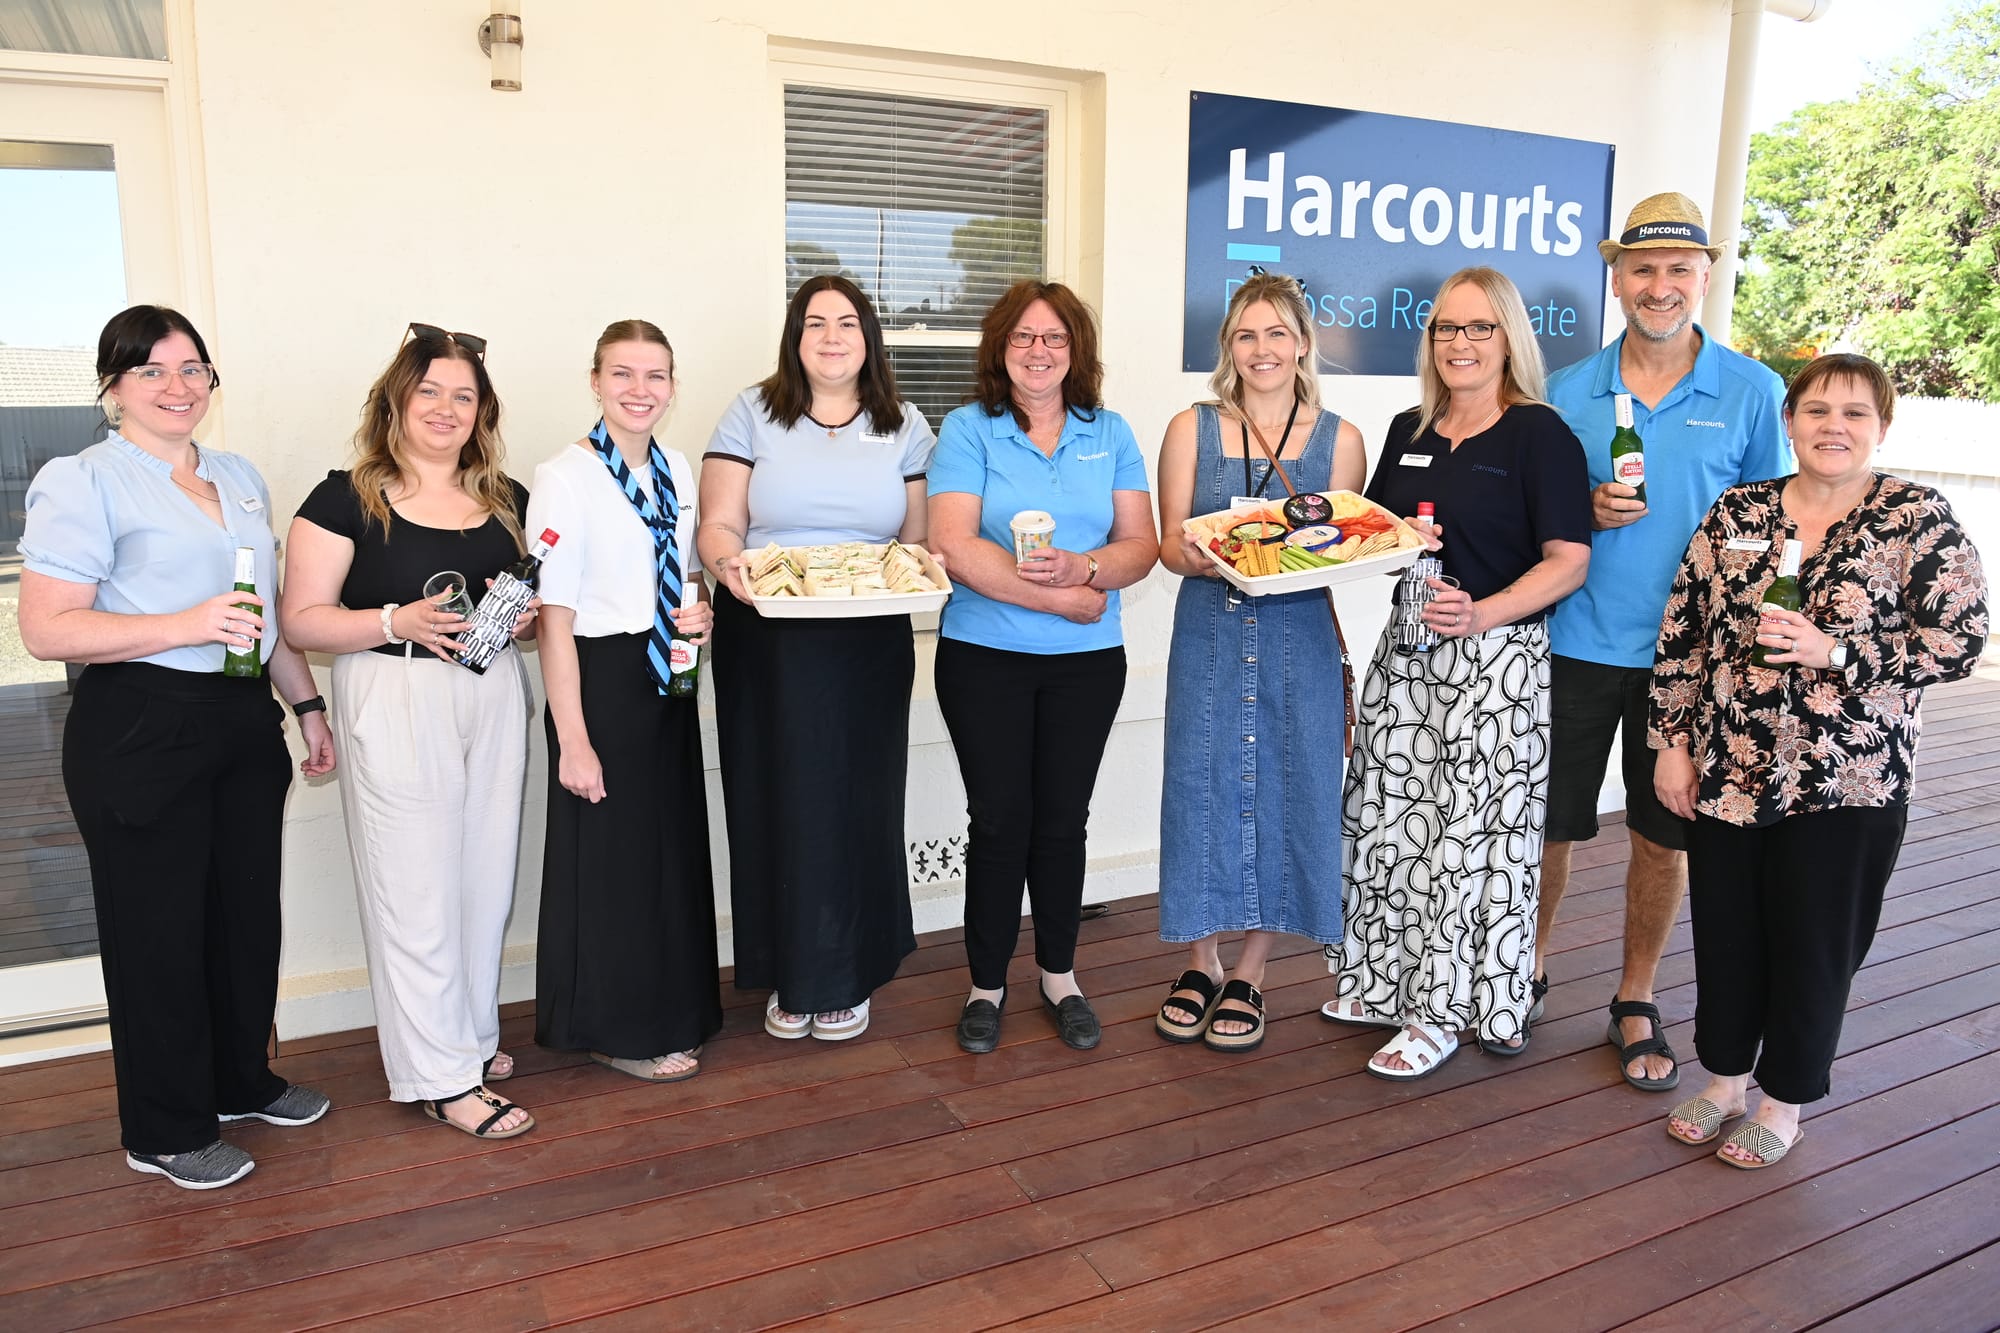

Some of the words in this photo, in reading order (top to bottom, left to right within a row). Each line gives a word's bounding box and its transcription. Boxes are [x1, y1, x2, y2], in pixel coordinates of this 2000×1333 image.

[1228, 148, 1582, 257] Harcourts
[1639, 226, 1691, 237] Harcourts
[1686, 418, 1725, 429] Harcourts
[1076, 451, 1109, 461] Harcourts
